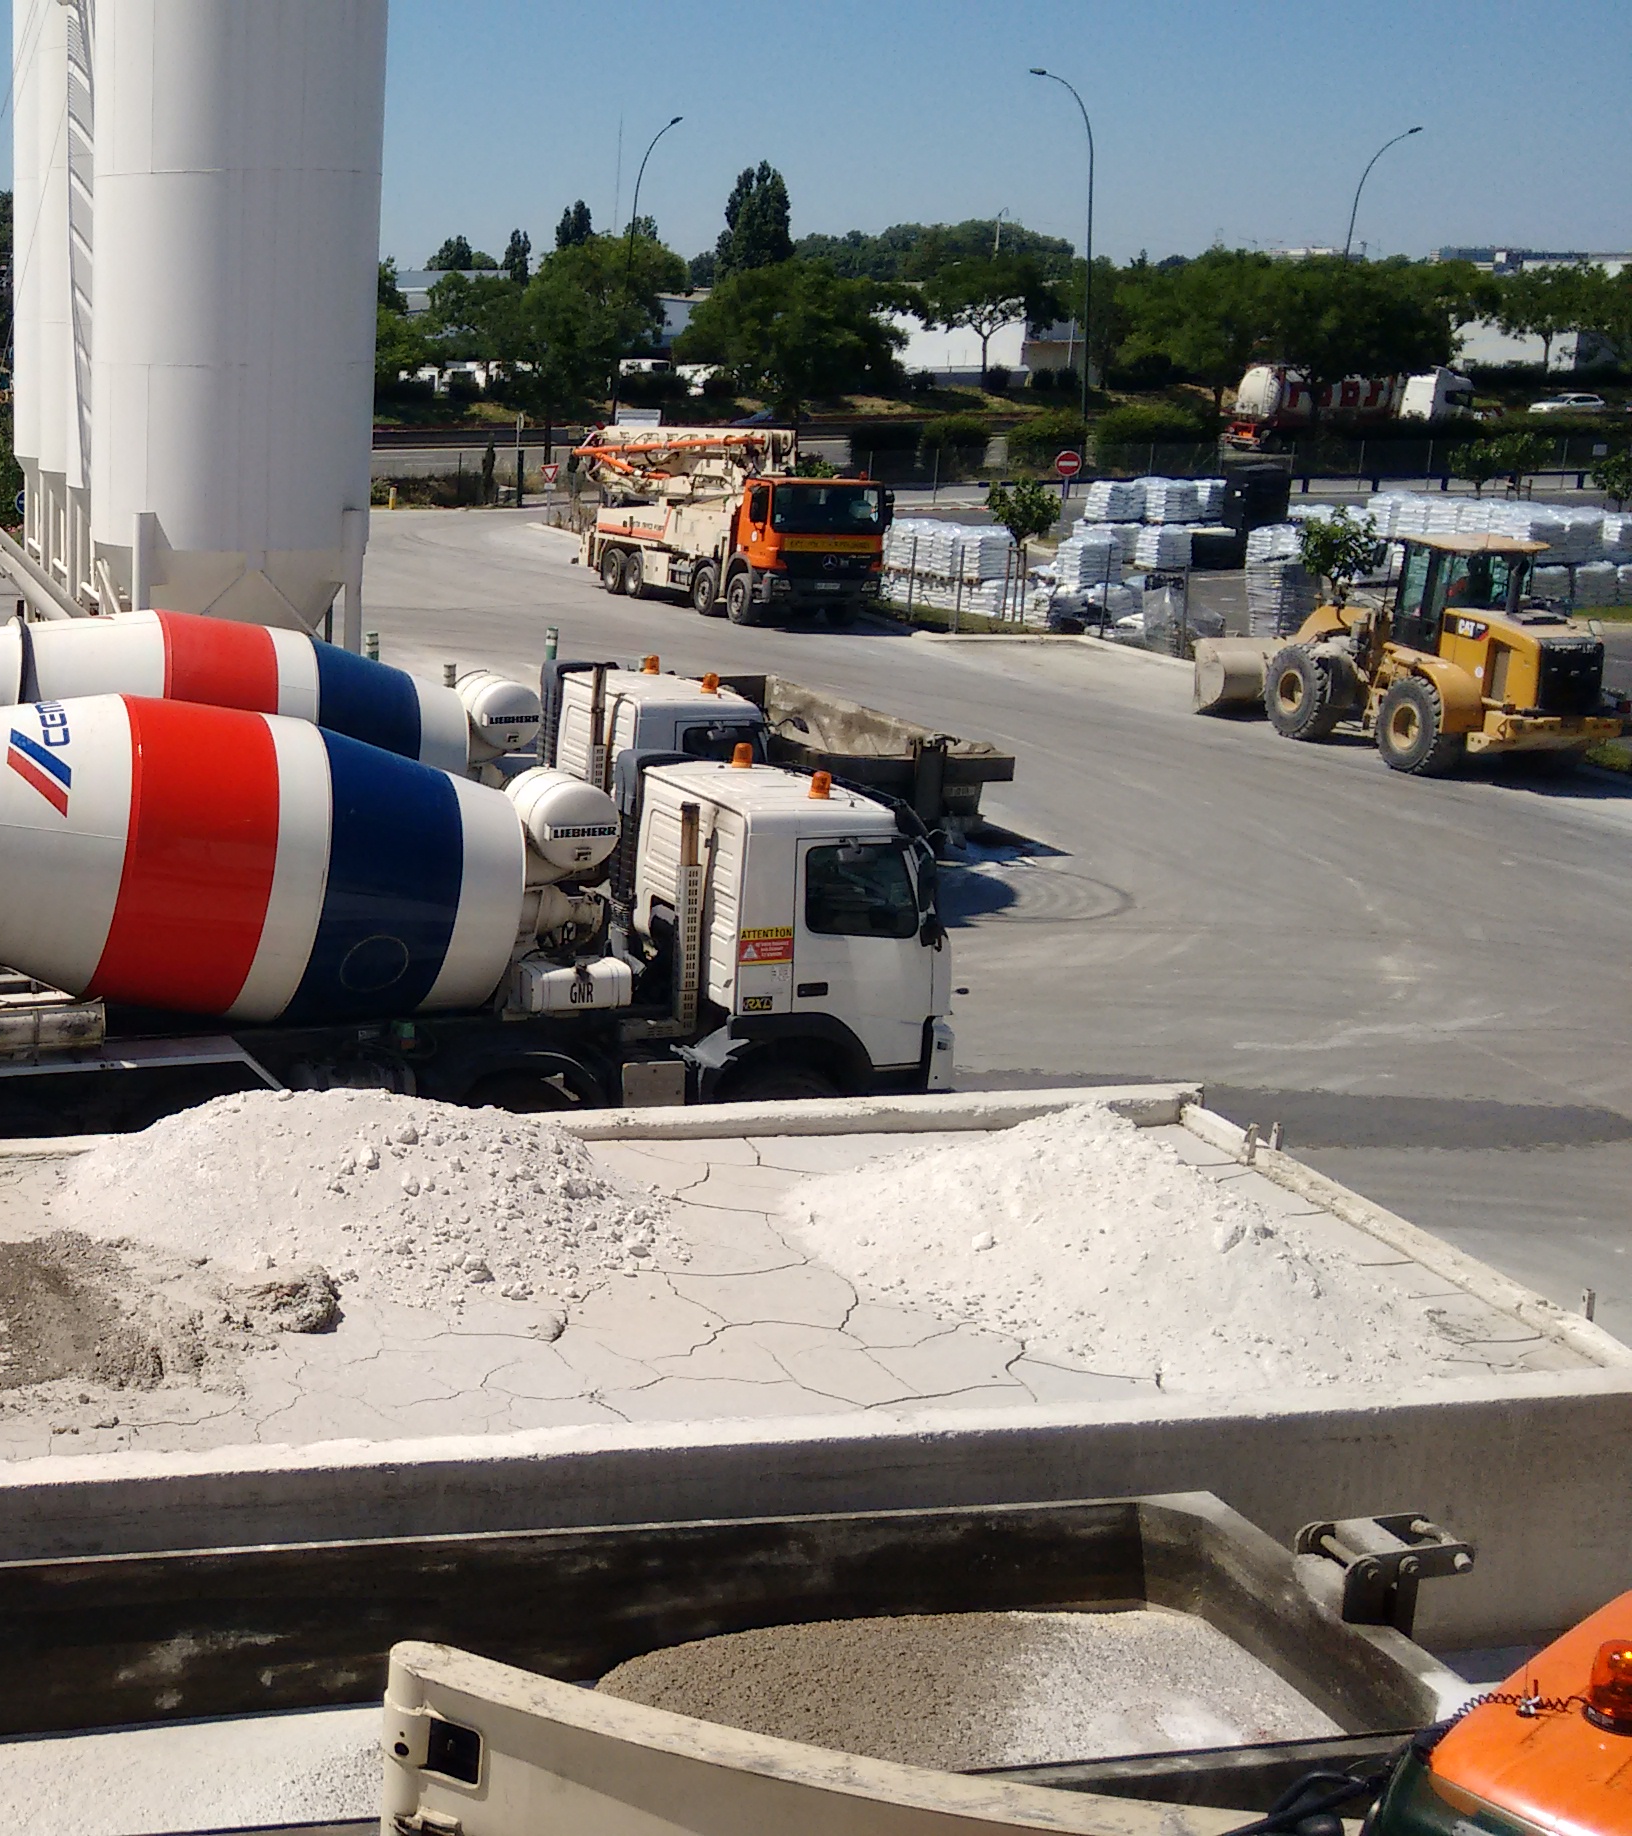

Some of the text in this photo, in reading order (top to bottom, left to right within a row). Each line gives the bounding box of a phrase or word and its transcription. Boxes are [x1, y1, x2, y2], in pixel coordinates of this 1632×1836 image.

[1458, 619, 1476, 637] CAT
[489, 714, 540, 725] LIEBHERR
[553, 826, 617, 839] LIEBHERR
[741, 927, 792, 940] ATTENTION
[570, 982, 594, 1004] GNR
